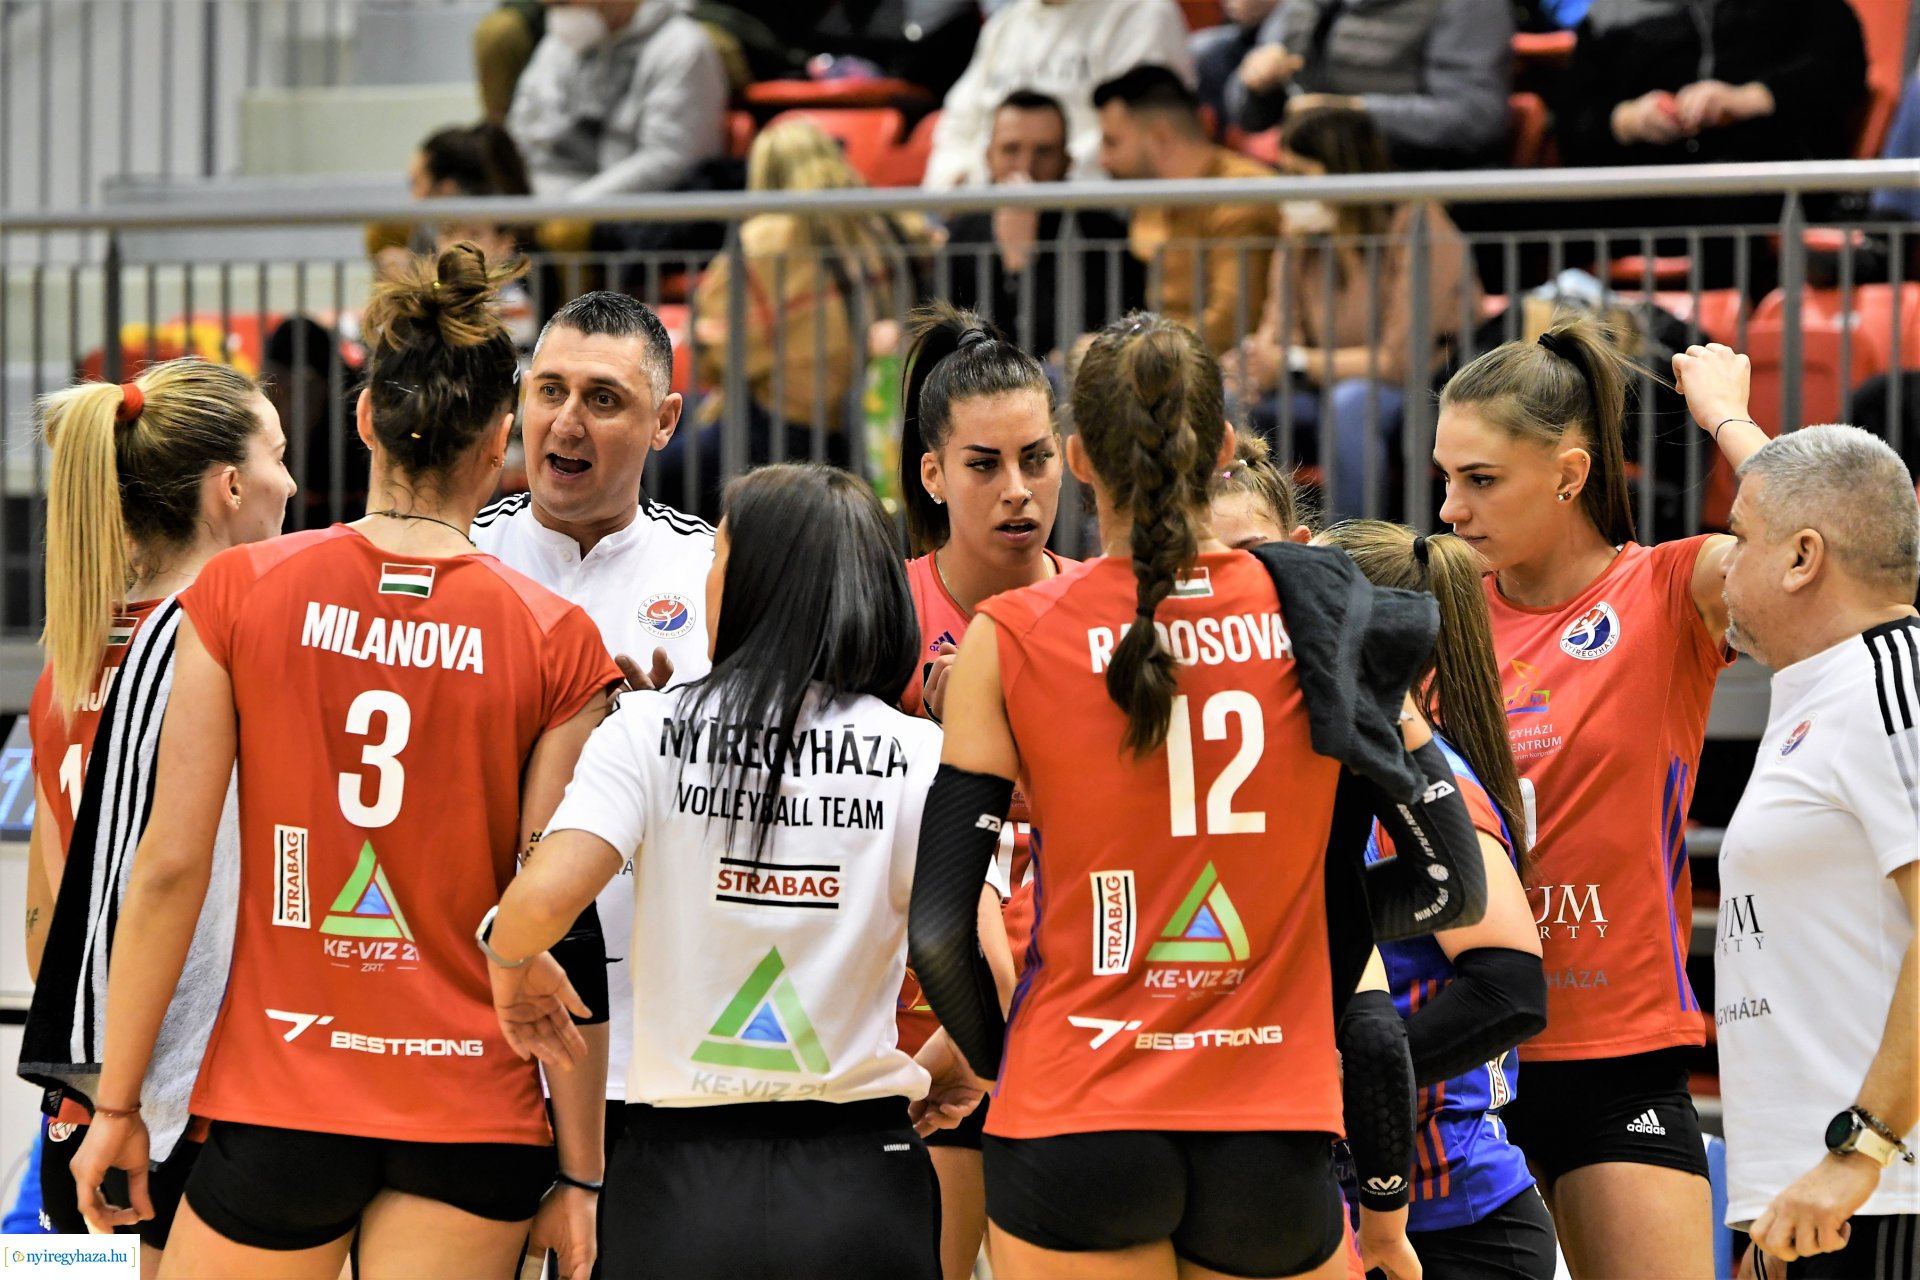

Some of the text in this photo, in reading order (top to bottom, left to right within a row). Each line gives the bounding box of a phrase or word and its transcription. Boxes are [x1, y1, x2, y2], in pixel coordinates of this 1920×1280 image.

[301, 601, 484, 674] MILANOVA
[1087, 612, 1295, 674] ROSOVA
[60, 743, 92, 822] 1
[338, 689, 411, 829] 3
[1166, 689, 1266, 837] 12
[678, 782, 884, 830] VOLLEYBALL TEAM
[287, 831, 299, 922] STRABAG
[717, 869, 840, 897] STRABAG
[1106, 875, 1121, 970] STRABAG
[324, 938, 398, 960] KE-VIZ
[1144, 968, 1245, 988] KE-VIZ 21
[330, 1031, 484, 1057] BESTRONG
[1135, 1025, 1283, 1050] BESTRONG
[691, 1072, 791, 1099] KE-VIZ
[1626, 1121, 1666, 1136] adidas
